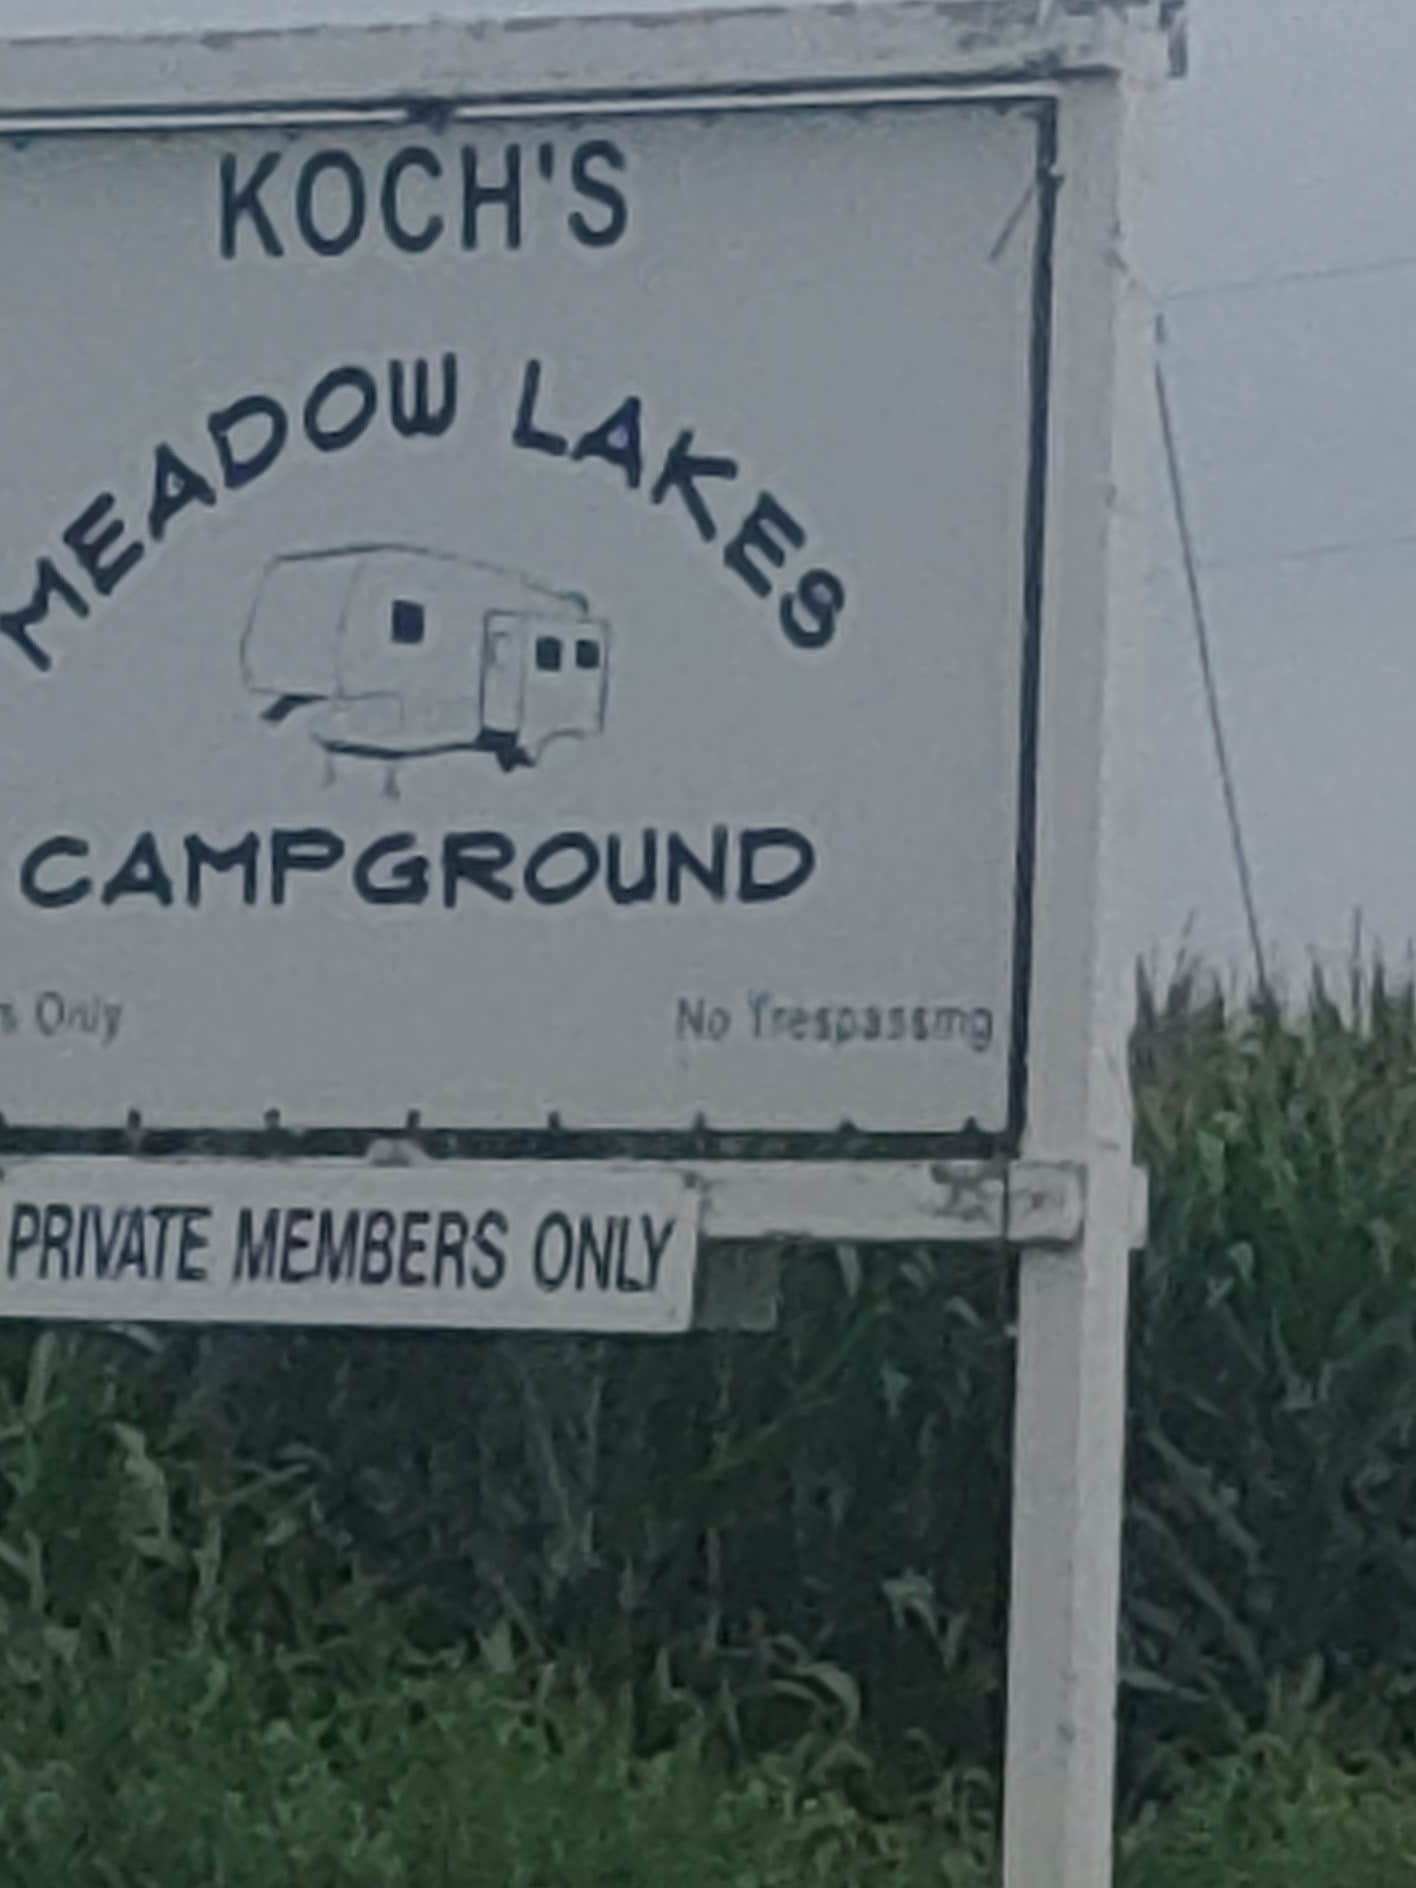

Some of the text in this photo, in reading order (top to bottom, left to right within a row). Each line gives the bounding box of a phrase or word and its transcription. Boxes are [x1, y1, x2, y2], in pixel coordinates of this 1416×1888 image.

[217, 138, 630, 259] KOCH'S
[512, 358, 847, 654] LAKES
[19, 823, 817, 910] CAMPGROUND
[34, 989, 124, 1047] Only
[675, 996, 732, 1042] No
[5, 1201, 677, 1294] PRIVATE MEMBERS ONLY
